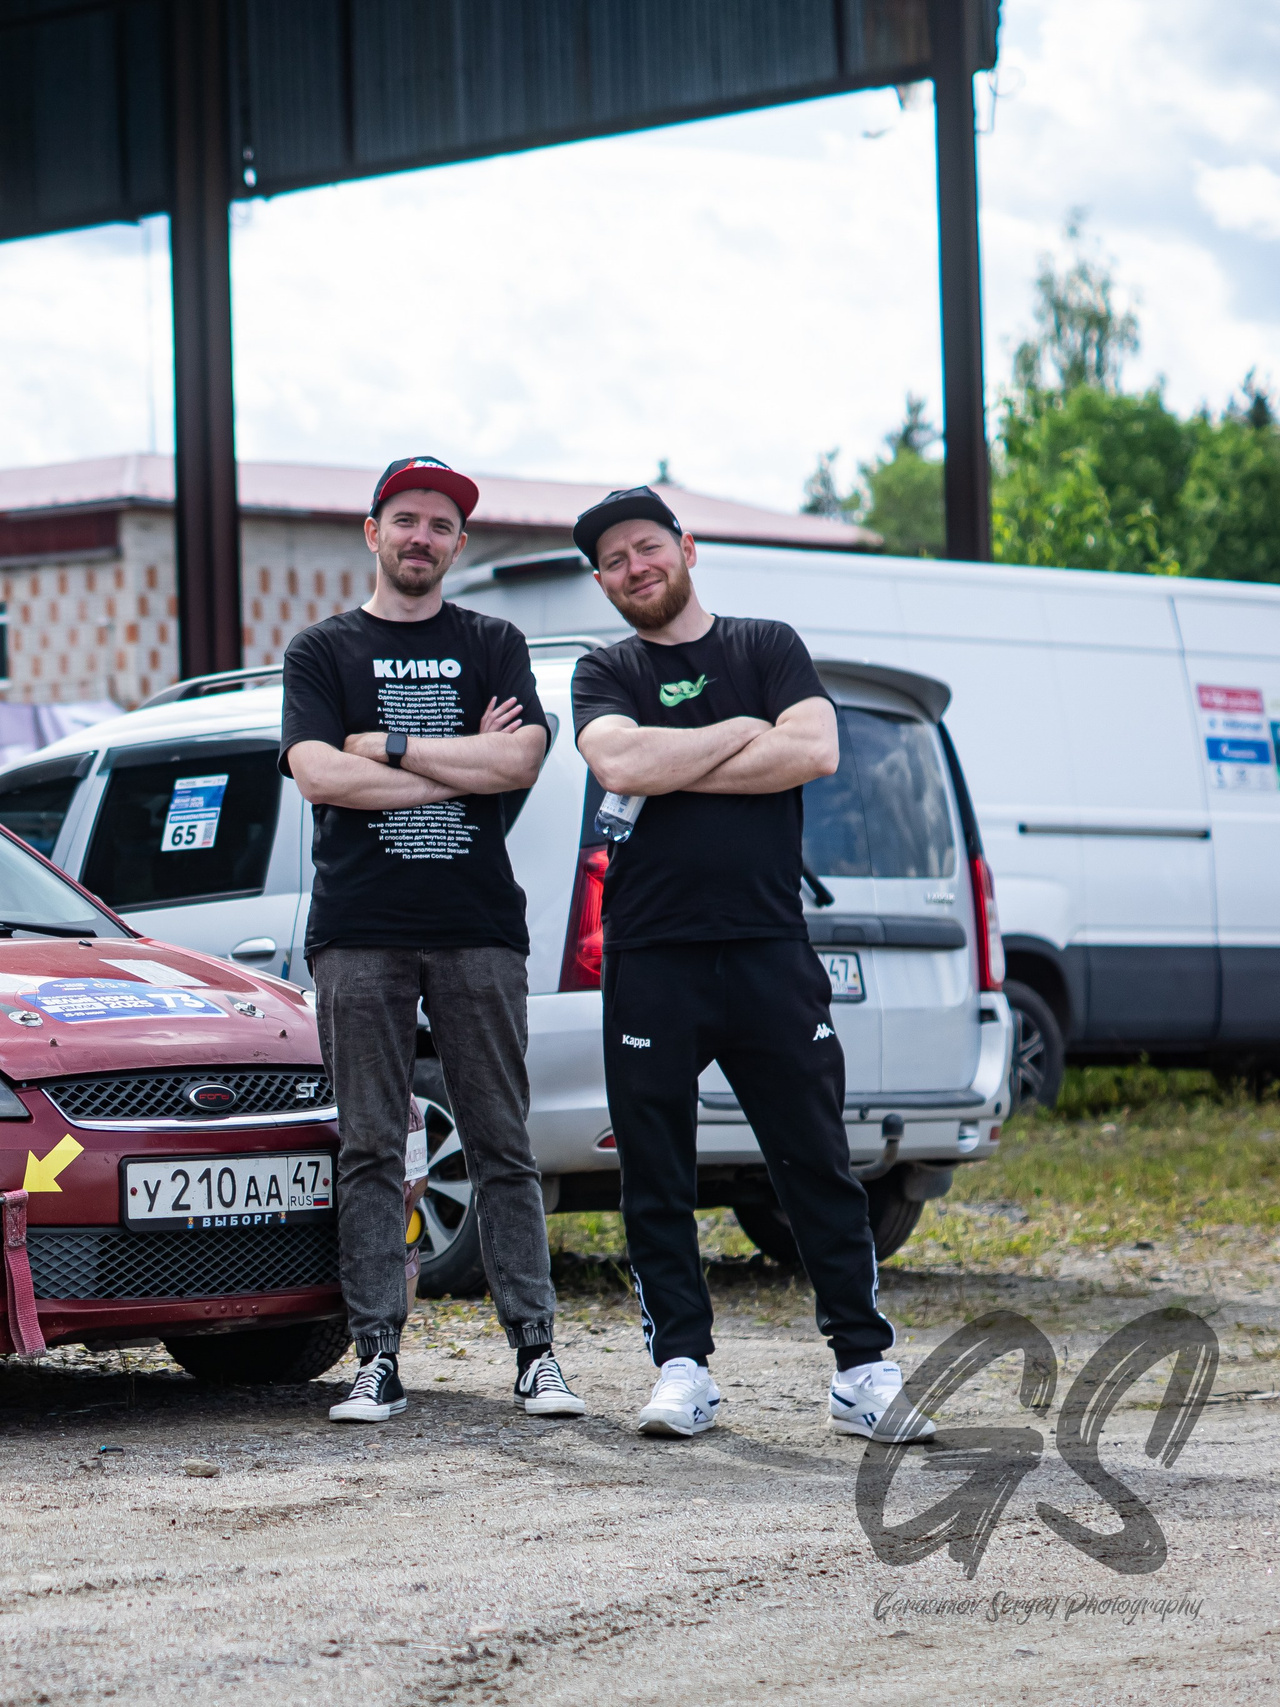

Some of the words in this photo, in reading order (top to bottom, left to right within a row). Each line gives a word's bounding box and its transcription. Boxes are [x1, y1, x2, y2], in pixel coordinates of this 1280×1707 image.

[373, 659, 461, 679] КИНО
[171, 824, 198, 846] 65
[830, 959, 849, 982] 47
[104, 1000, 155, 1008] 2025
[146, 993, 206, 1009] 73
[622, 1034, 651, 1048] Kappa
[296, 1082, 319, 1099] ST
[143, 1167, 283, 1212] У210АА
[292, 1161, 320, 1193] 47
[291, 1196, 312, 1206] RUS
[202, 1214, 272, 1228] ВЫБОРГ
